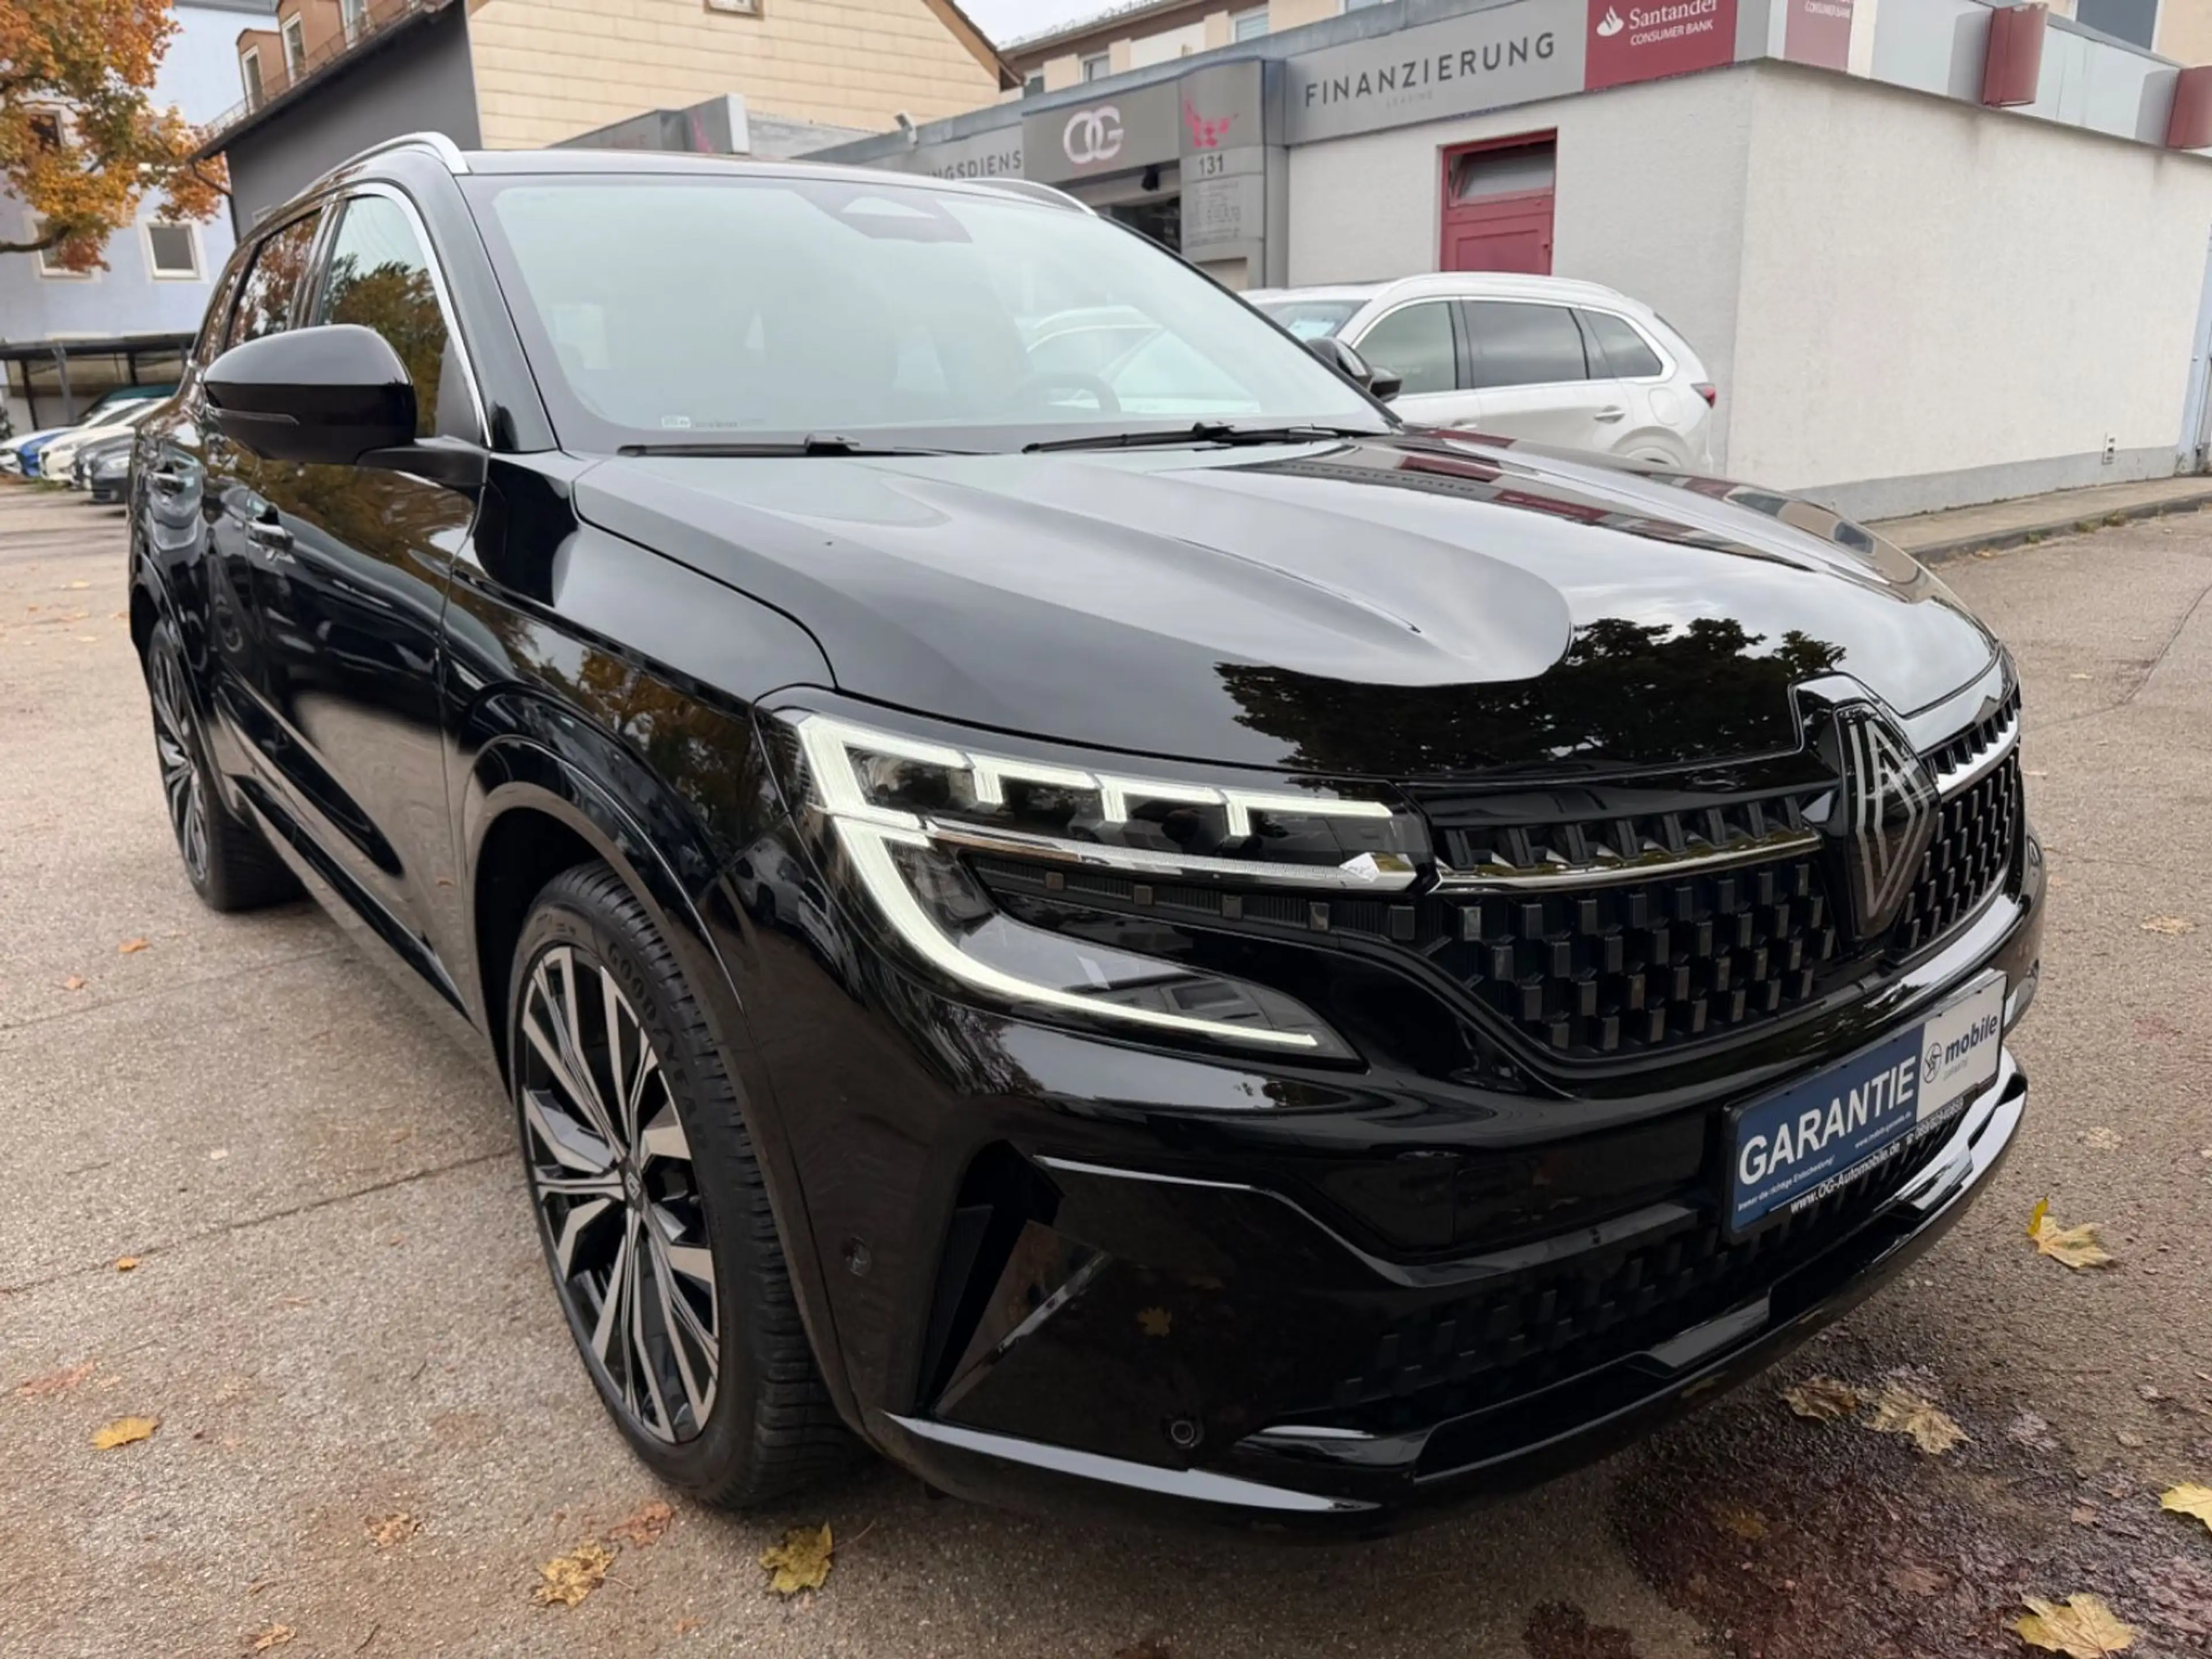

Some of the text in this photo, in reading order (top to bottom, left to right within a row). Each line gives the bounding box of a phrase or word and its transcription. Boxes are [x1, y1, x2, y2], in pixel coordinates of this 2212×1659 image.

[1629, 0, 1717, 29] Santander
[1630, 19, 1713, 46] CONSUMER BANK
[1305, 32, 1554, 107] FINANZIERUNG
[1063, 105, 1124, 164] OG
[927, 150, 1021, 180] NGSDIENS
[1199, 154, 1224, 175] 131
[1945, 1014, 1998, 1065] mobile
[1738, 1056, 1916, 1185] GARANTIE
